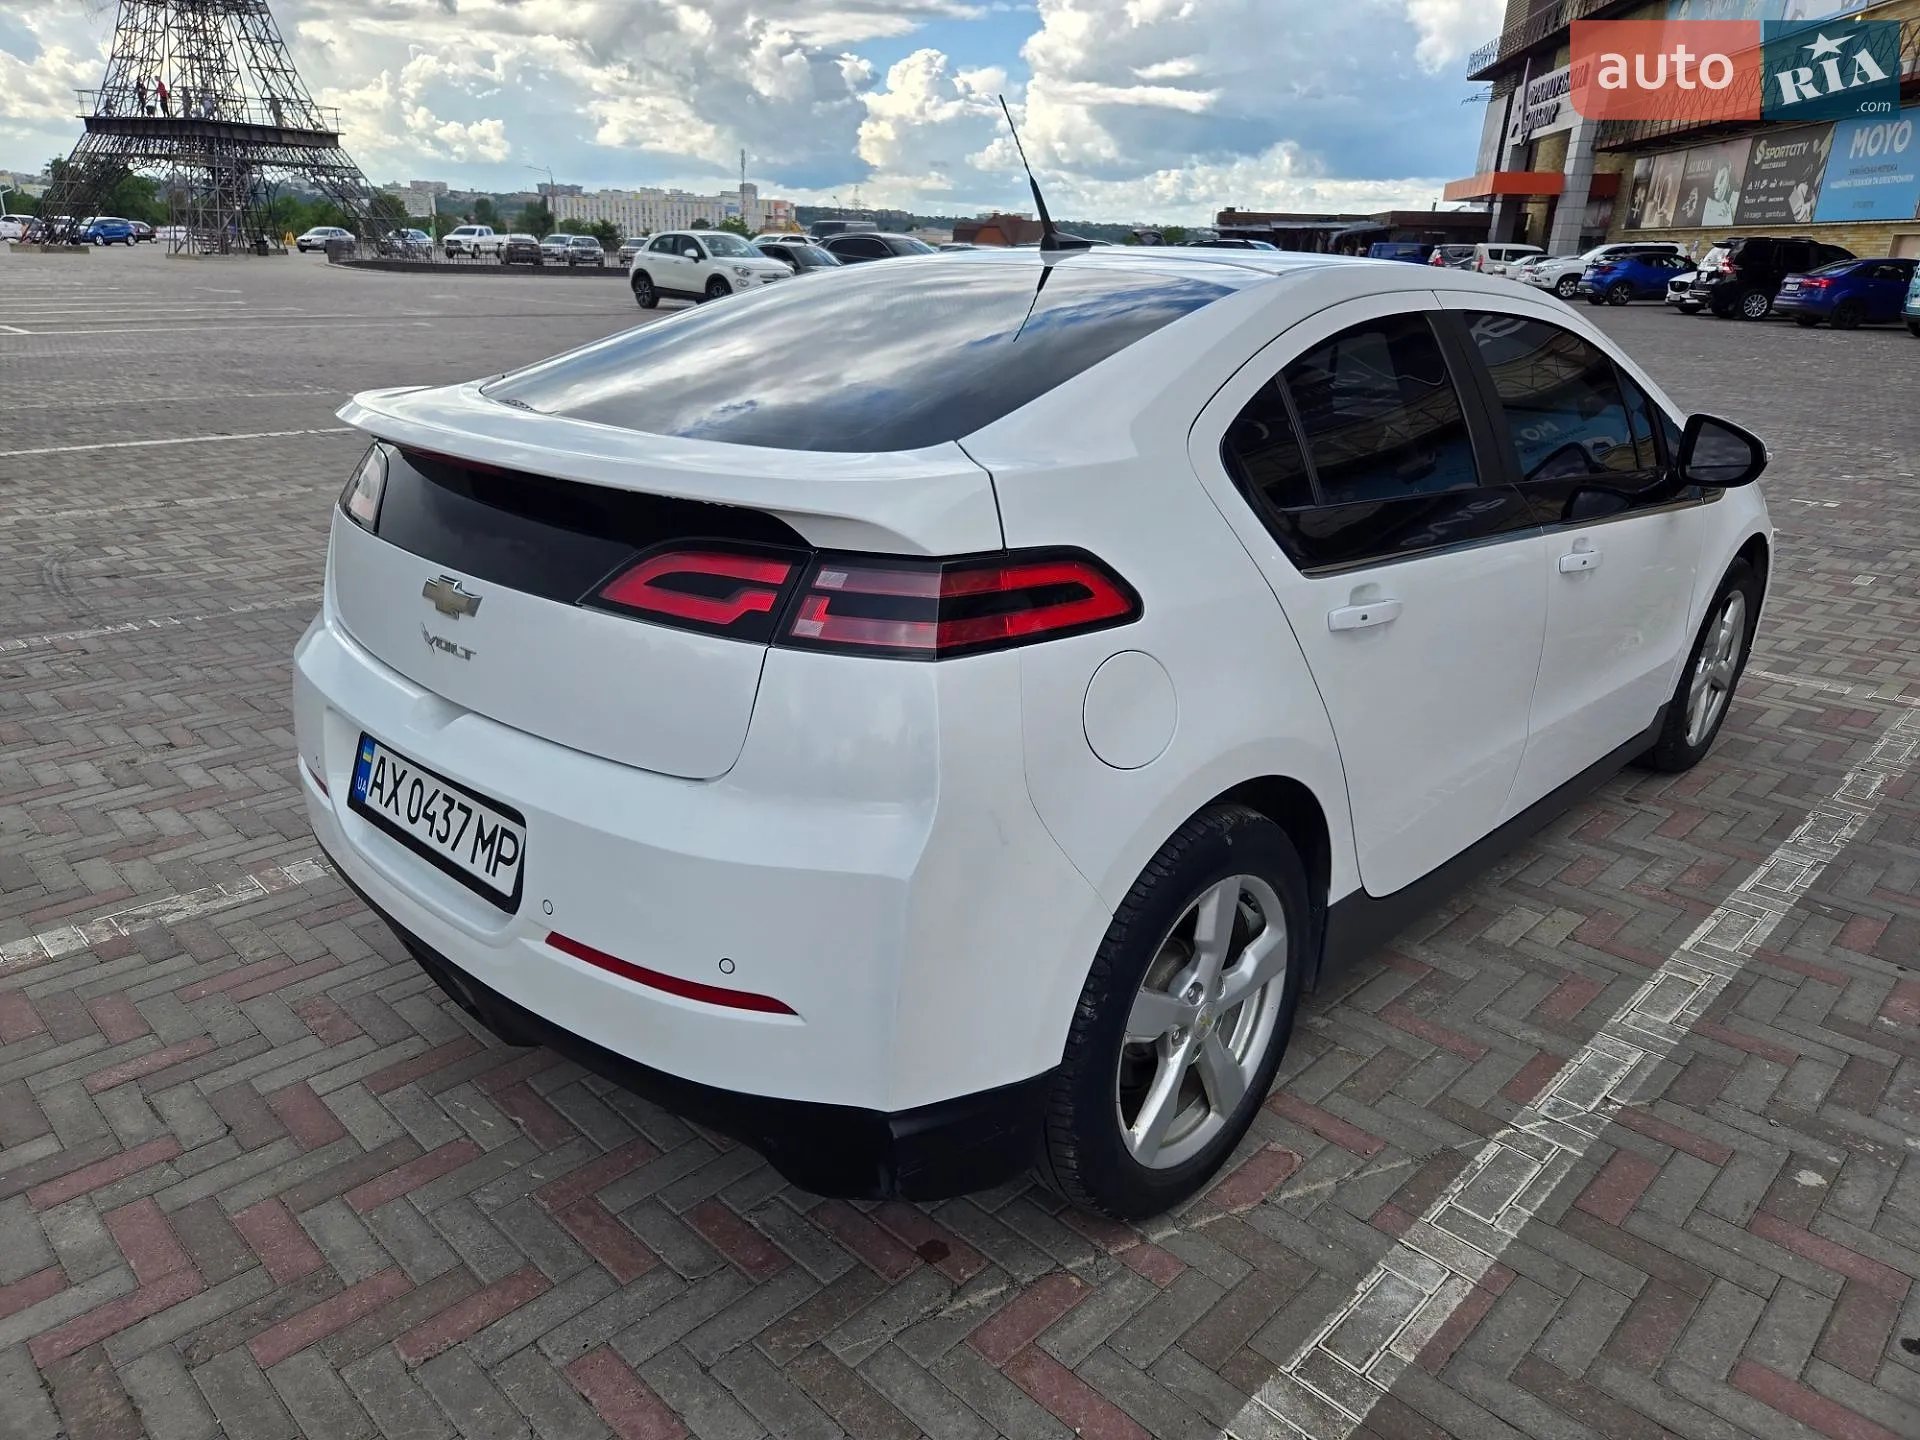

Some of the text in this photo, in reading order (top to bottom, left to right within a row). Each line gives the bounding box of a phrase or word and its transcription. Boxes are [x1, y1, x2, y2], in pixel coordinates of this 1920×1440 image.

[1763, 142, 1810, 160] SPORTCITY
[1849, 119, 1913, 160] MOYO
[421, 622, 477, 661] VOLT
[357, 776, 367, 794] UA
[369, 756, 519, 878] AX 0437 MP
